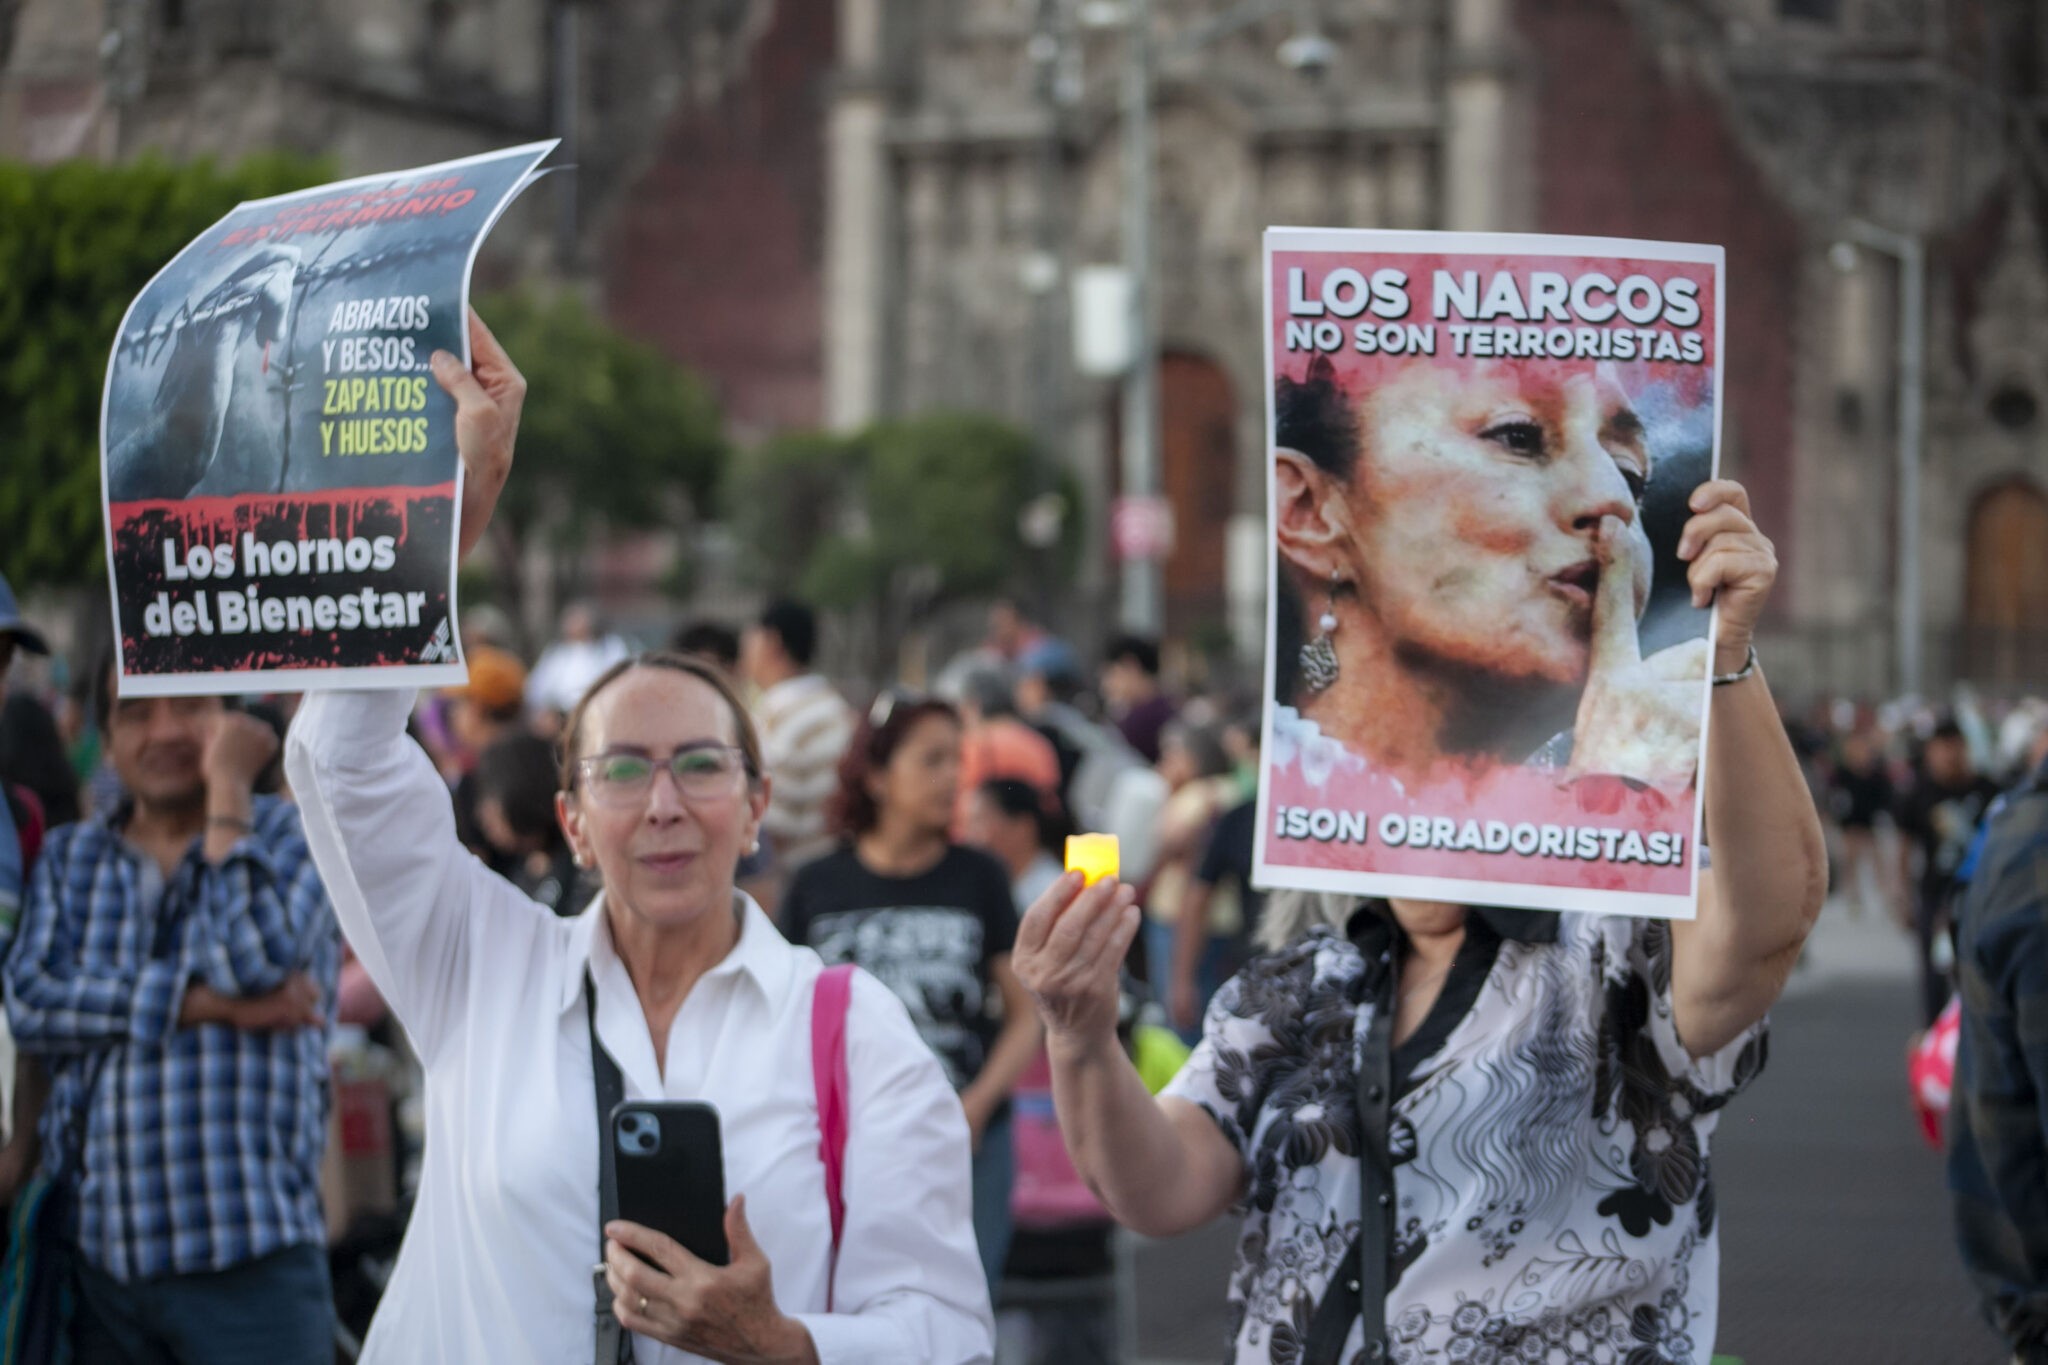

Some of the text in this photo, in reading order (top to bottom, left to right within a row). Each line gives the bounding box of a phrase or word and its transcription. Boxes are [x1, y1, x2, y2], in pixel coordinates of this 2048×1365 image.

[219, 188, 478, 248] EXTERMINIO
[328, 295, 431, 334] ABRAZOS
[1287, 267, 1702, 327] LOS NARCOS
[322, 339, 337, 374] Y
[1285, 320, 1705, 364] NO SON TERRORISTAS
[323, 376, 429, 416] ZAPATOS
[320, 417, 429, 457] Y HUESOS
[162, 532, 396, 581] Los hornos
[144, 584, 427, 637] del Bienestar
[1275, 806, 1684, 865] ¡SON OBRADORISTAS!
